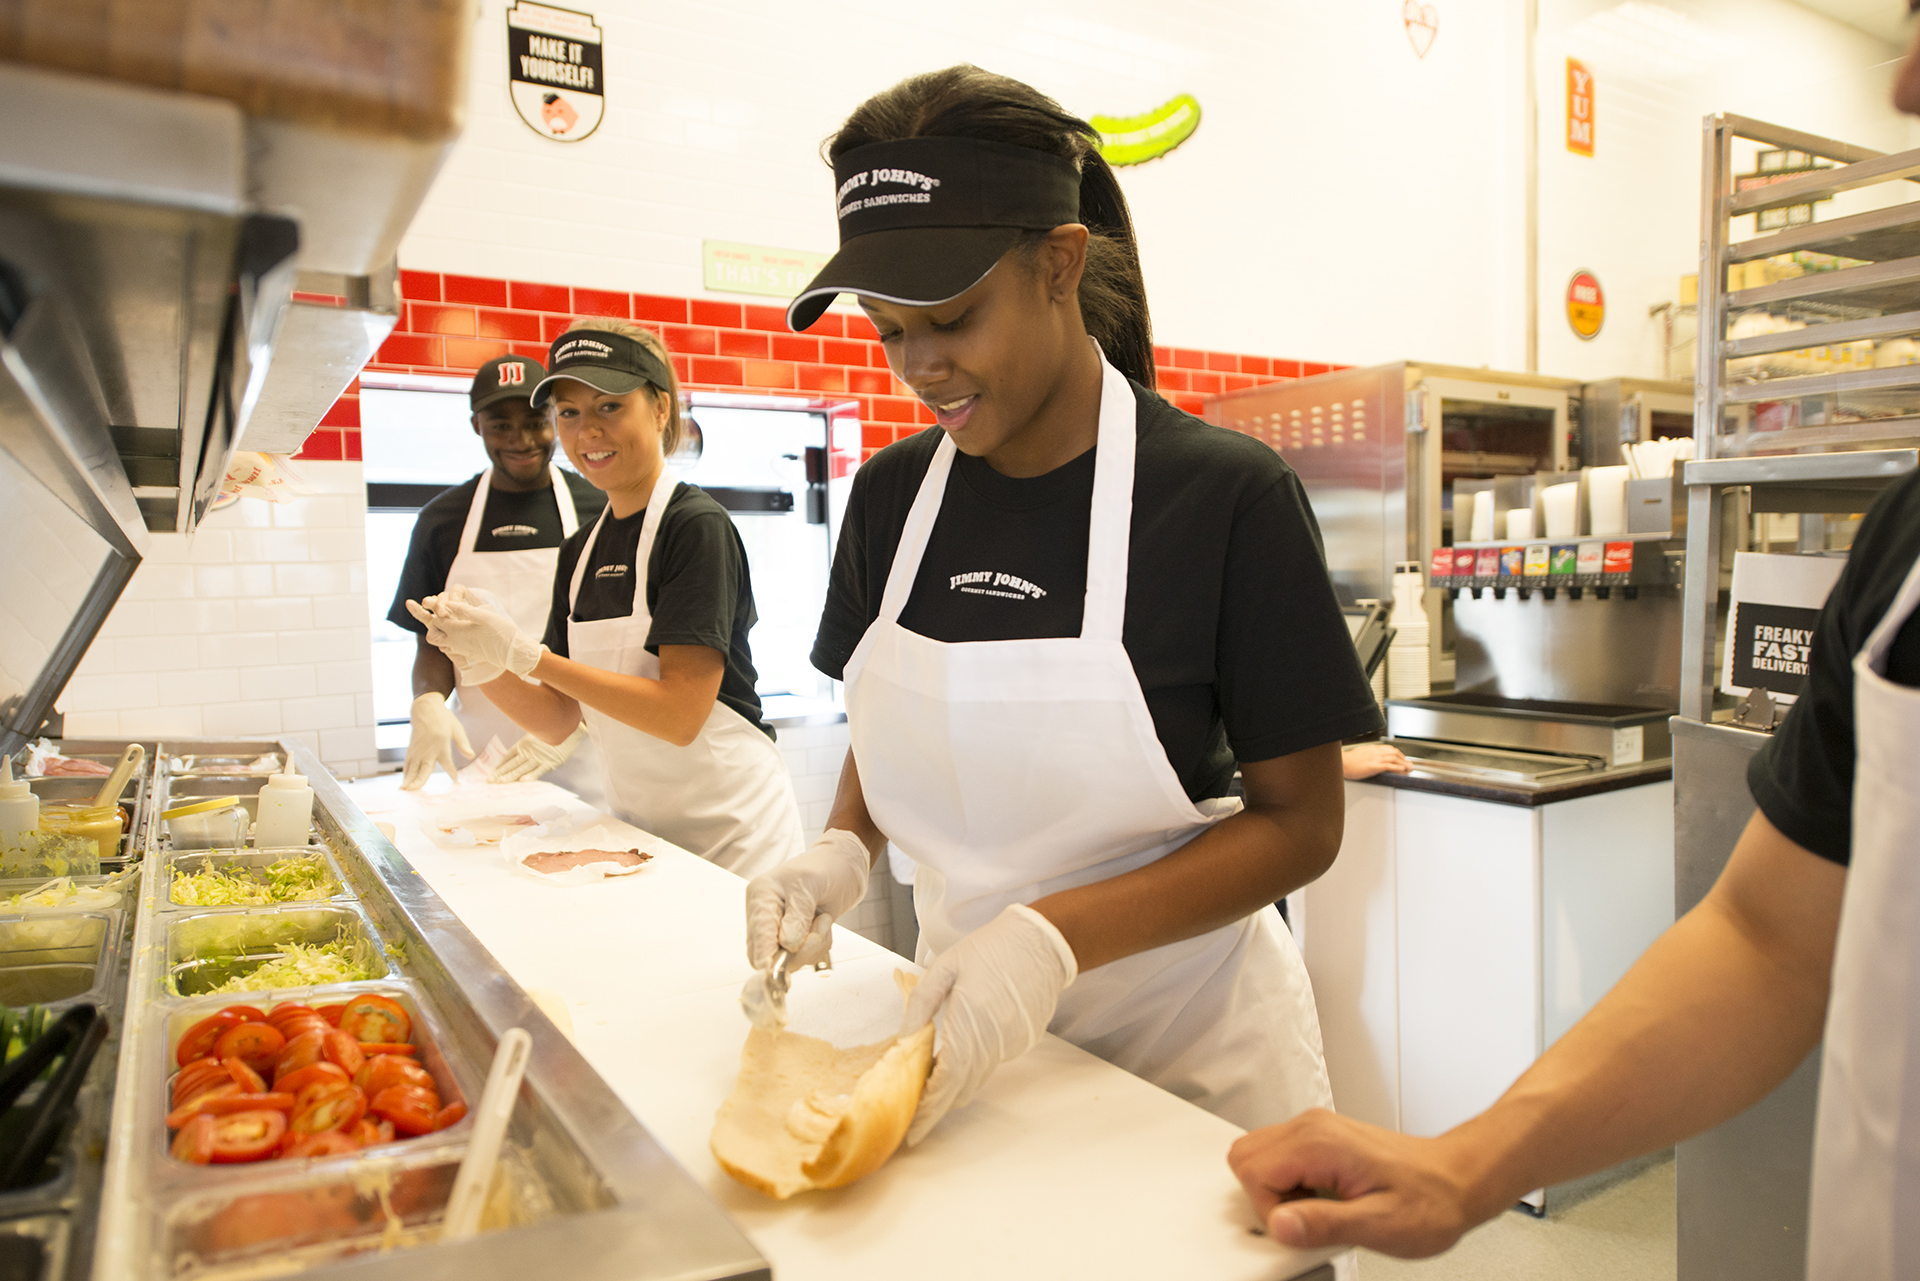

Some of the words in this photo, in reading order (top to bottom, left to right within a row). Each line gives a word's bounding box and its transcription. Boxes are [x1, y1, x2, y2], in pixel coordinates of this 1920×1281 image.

[529, 34, 567, 62] MAKE
[568, 42, 583, 64] IT
[520, 54, 595, 89] YOURSELF!
[1569, 69, 1592, 145] YUM
[864, 193, 931, 208] SANDWICHES
[714, 262, 779, 287] THAT'S
[498, 362, 525, 386] JJ
[949, 571, 993, 590] JIMMY
[985, 589, 1025, 600] SANDWICHES
[1754, 625, 1814, 646] FREAKY
[1753, 641, 1811, 662] FAST
